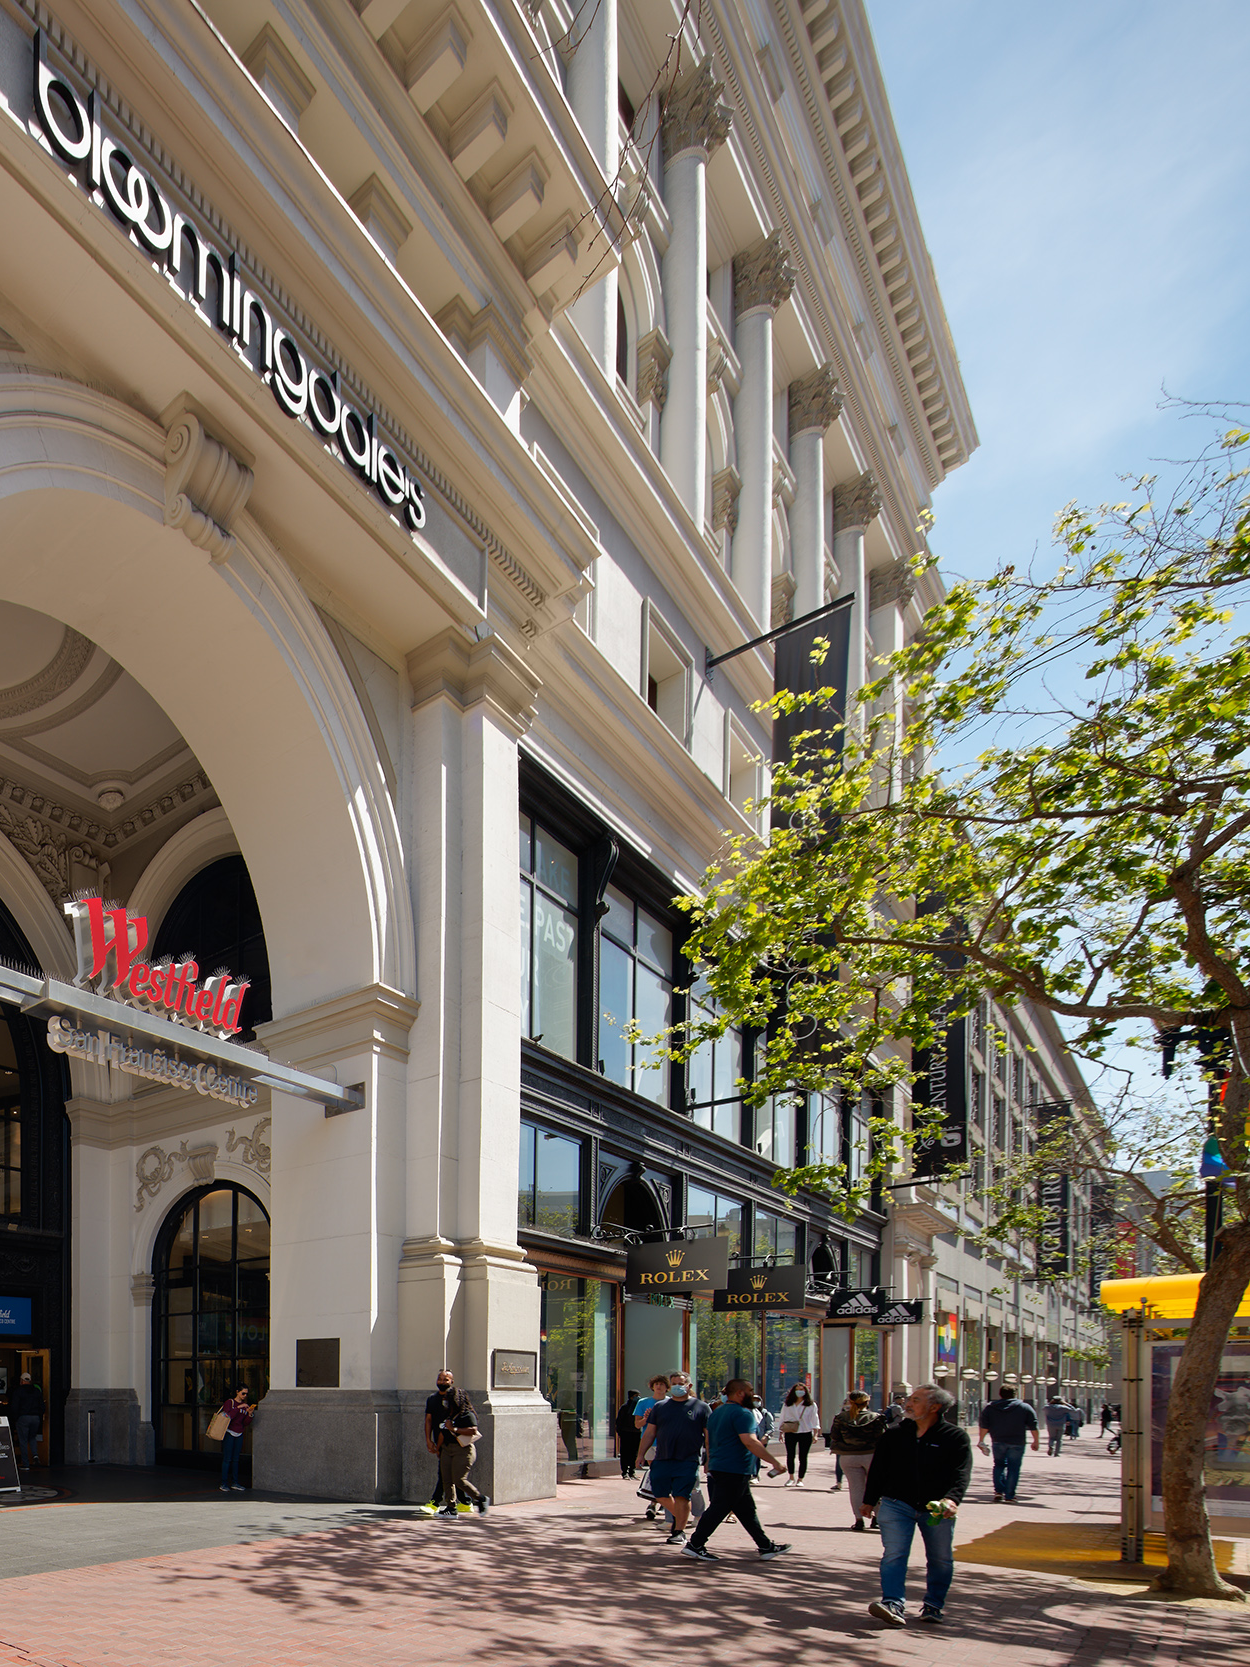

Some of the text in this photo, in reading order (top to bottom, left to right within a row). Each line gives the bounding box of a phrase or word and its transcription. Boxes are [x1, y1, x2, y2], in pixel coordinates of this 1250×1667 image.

[78, 897, 251, 1036] Westfield
[49, 1015, 259, 1105] San Francisco Centre
[640, 1268, 710, 1285] ROLEX
[727, 1292, 790, 1305] ROLEX
[836, 1306, 878, 1315] adidas
[877, 1315, 917, 1324] adidas
